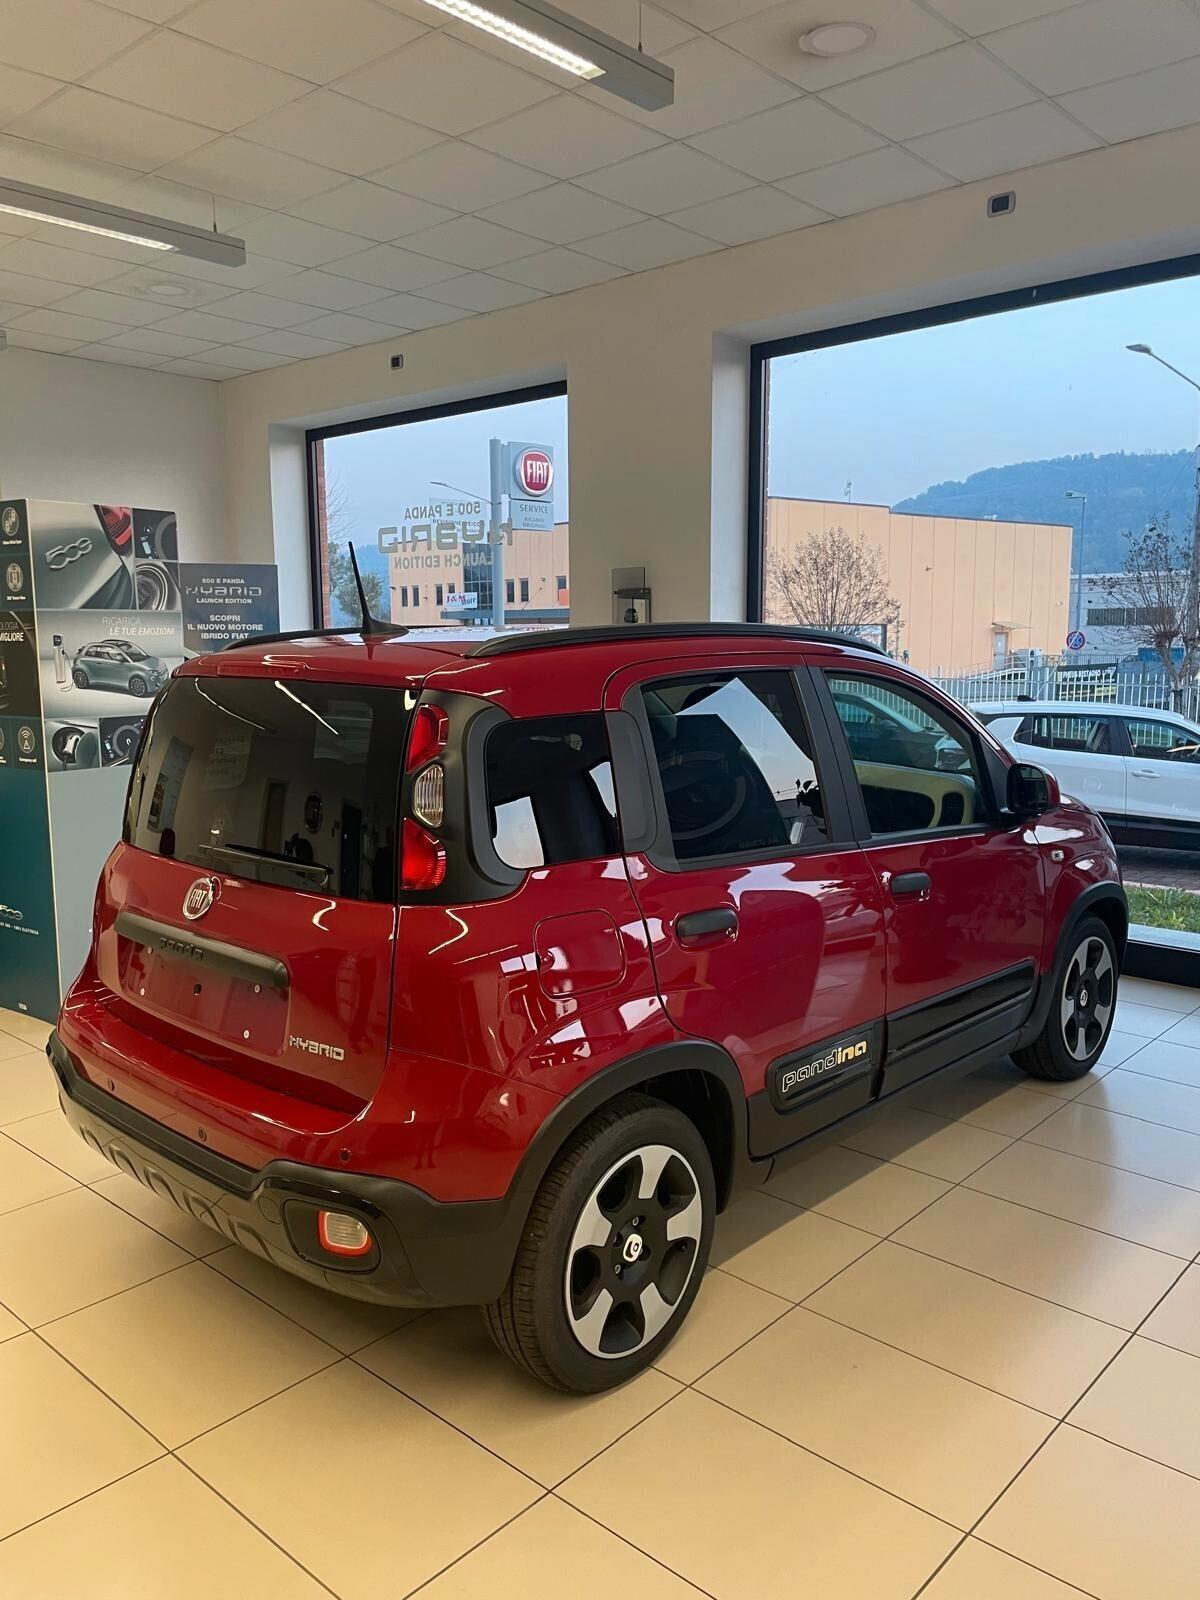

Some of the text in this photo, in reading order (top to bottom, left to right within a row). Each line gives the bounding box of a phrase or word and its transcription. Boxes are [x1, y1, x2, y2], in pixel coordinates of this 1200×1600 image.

[526, 460, 548, 484] FIAT
[520, 504, 548, 514] SERVICE
[186, 586, 262, 597] HYBRID
[102, 616, 142, 626] RICARICA
[209, 614, 241, 622] SCOPRI
[109, 627, 176, 637] LE TUE EMOZIONI
[187, 623, 195, 631] IL
[197, 623, 226, 631] NUOVO
[201, 632, 250, 640] IBRIDO FIAT
[187, 888, 208, 909] FIAT
[289, 1035, 345, 1061] HYBRID
[782, 1040, 867, 1093] pandina
